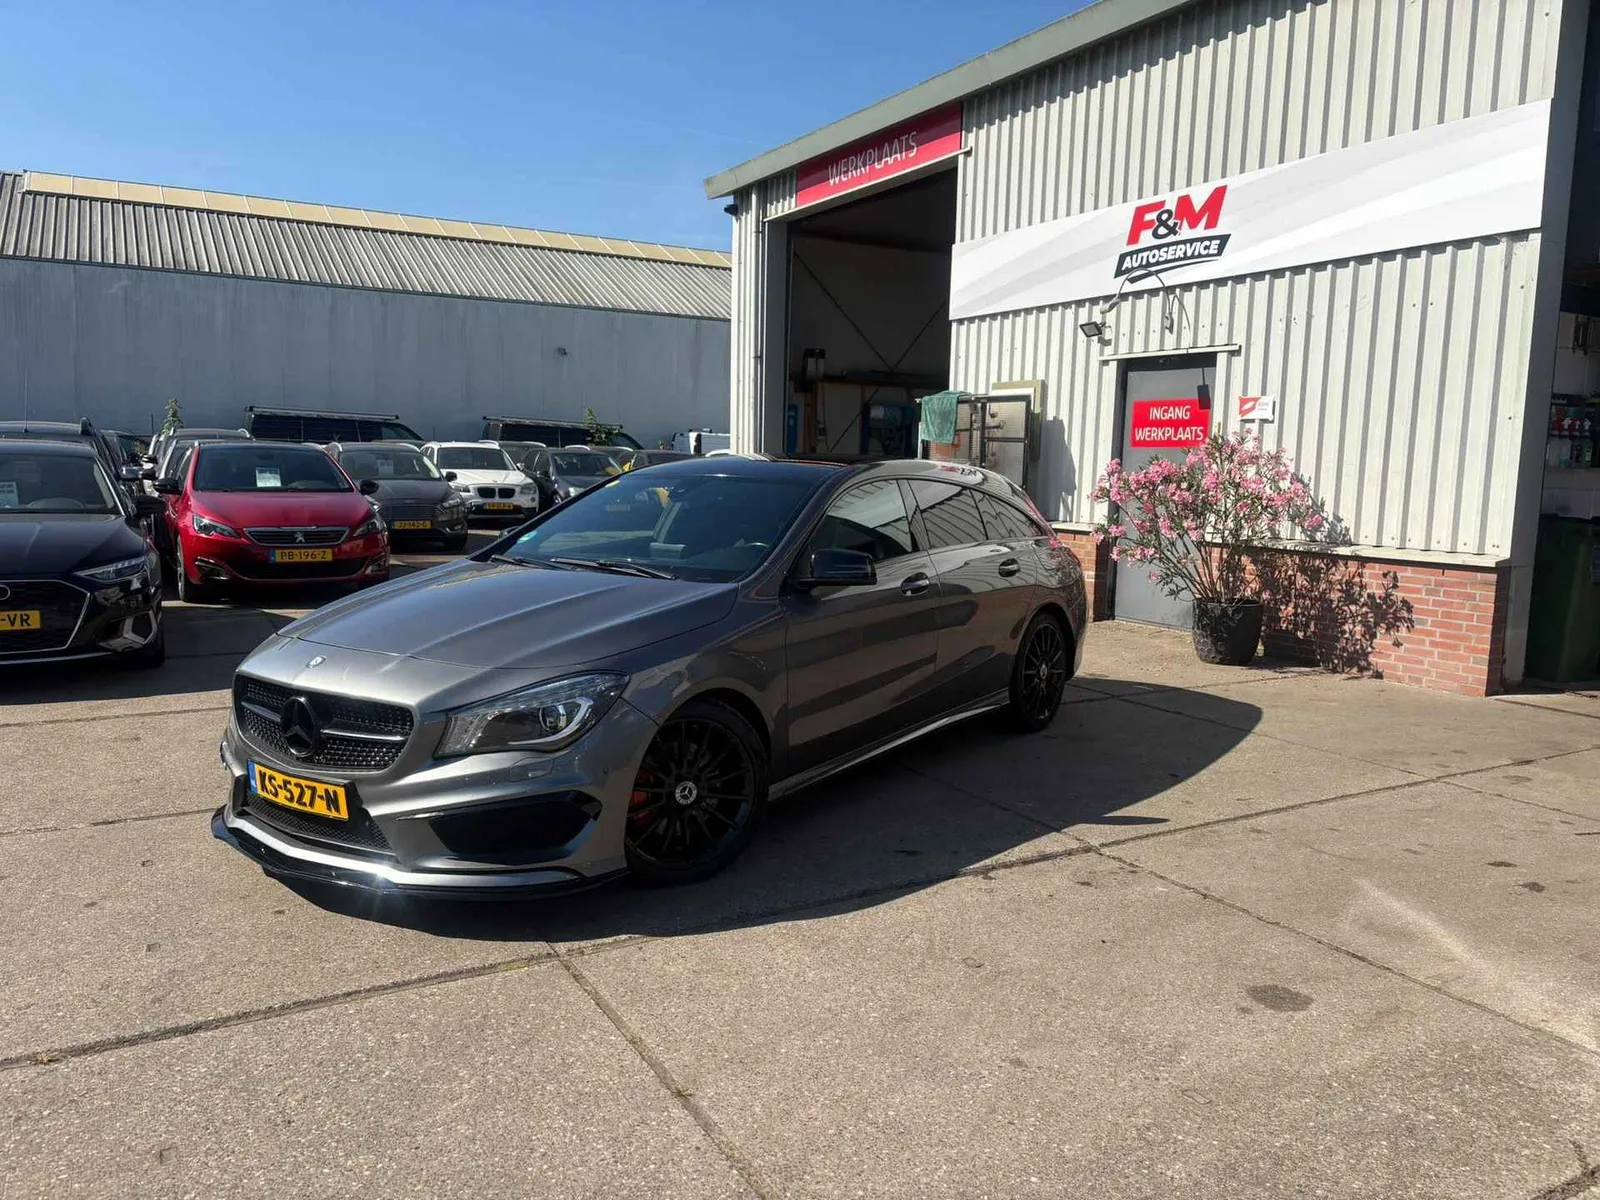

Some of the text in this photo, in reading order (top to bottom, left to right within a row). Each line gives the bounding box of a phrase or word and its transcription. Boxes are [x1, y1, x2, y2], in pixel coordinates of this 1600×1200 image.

[828, 131, 918, 186] WERKPLAATS
[1126, 184, 1228, 246] F&M
[1121, 239, 1221, 270] AUTOSERVICE
[1149, 405, 1191, 420] INGANG
[1135, 426, 1204, 441] WERKPLAATS
[280, 550, 327, 560] PB-196-Z
[259, 769, 341, 815] KS-527-N
